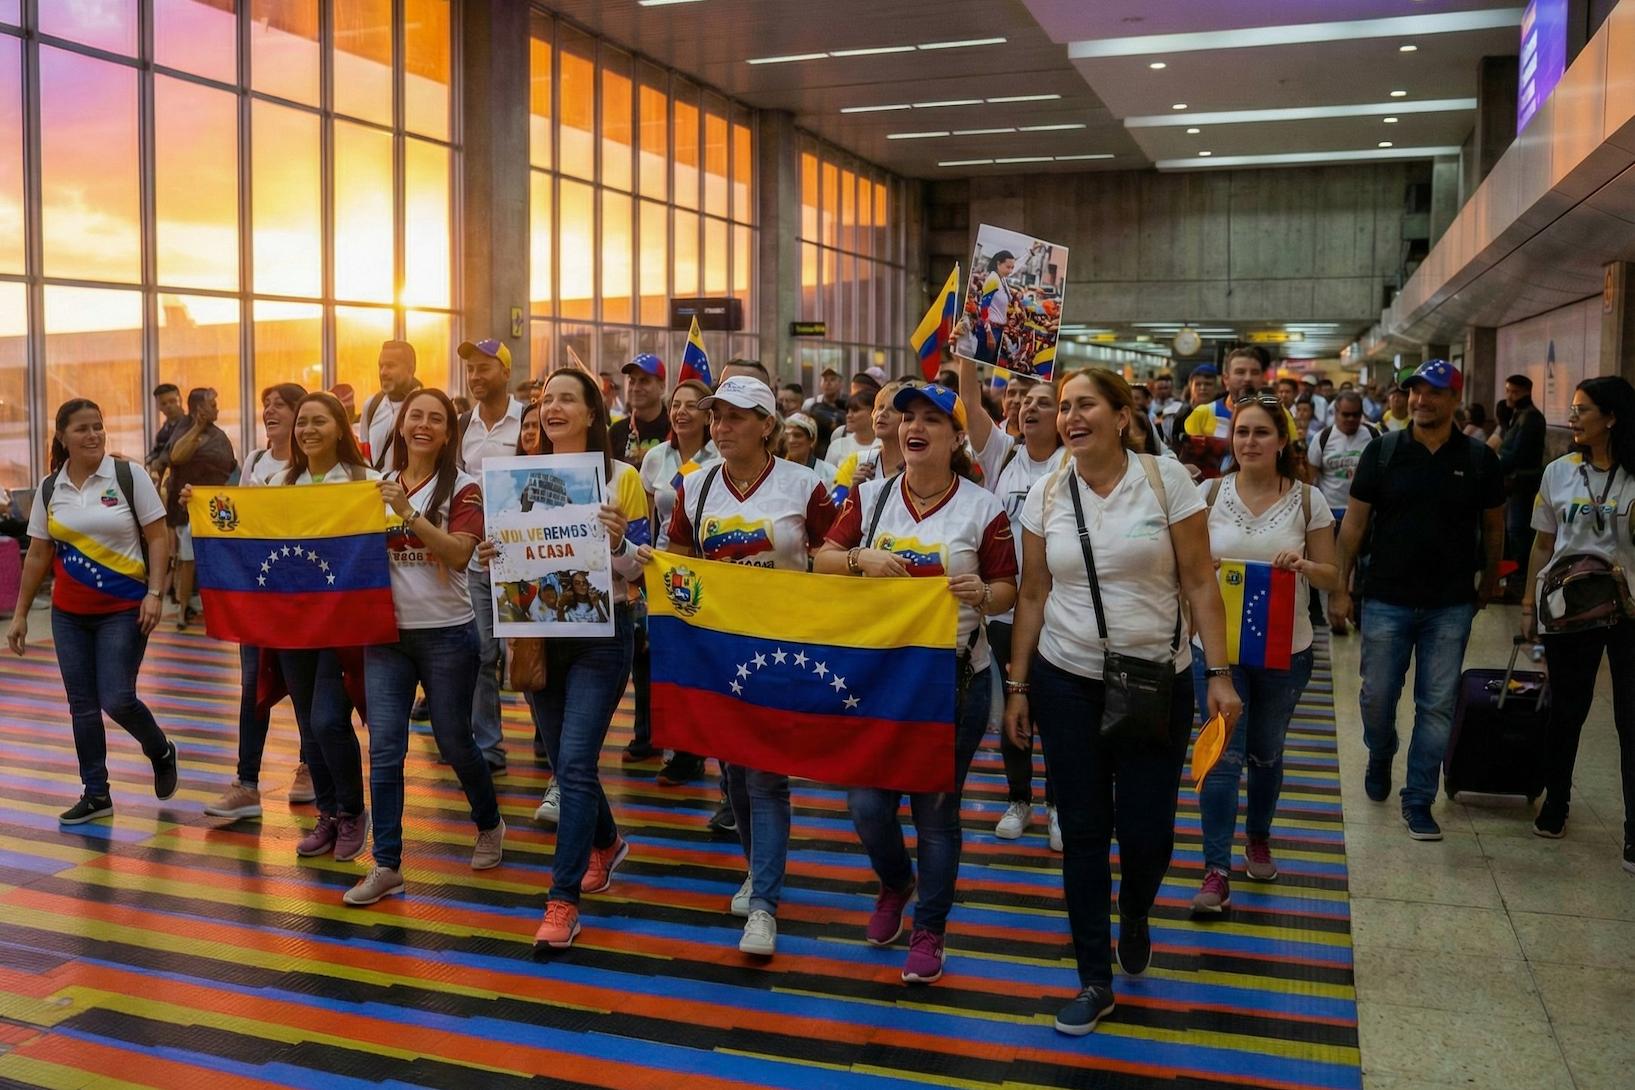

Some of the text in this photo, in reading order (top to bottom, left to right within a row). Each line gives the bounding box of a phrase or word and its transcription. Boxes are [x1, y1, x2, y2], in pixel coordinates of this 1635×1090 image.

[500, 524, 588, 544] VOLVEREMOS
[526, 543, 575, 560] A CASA
